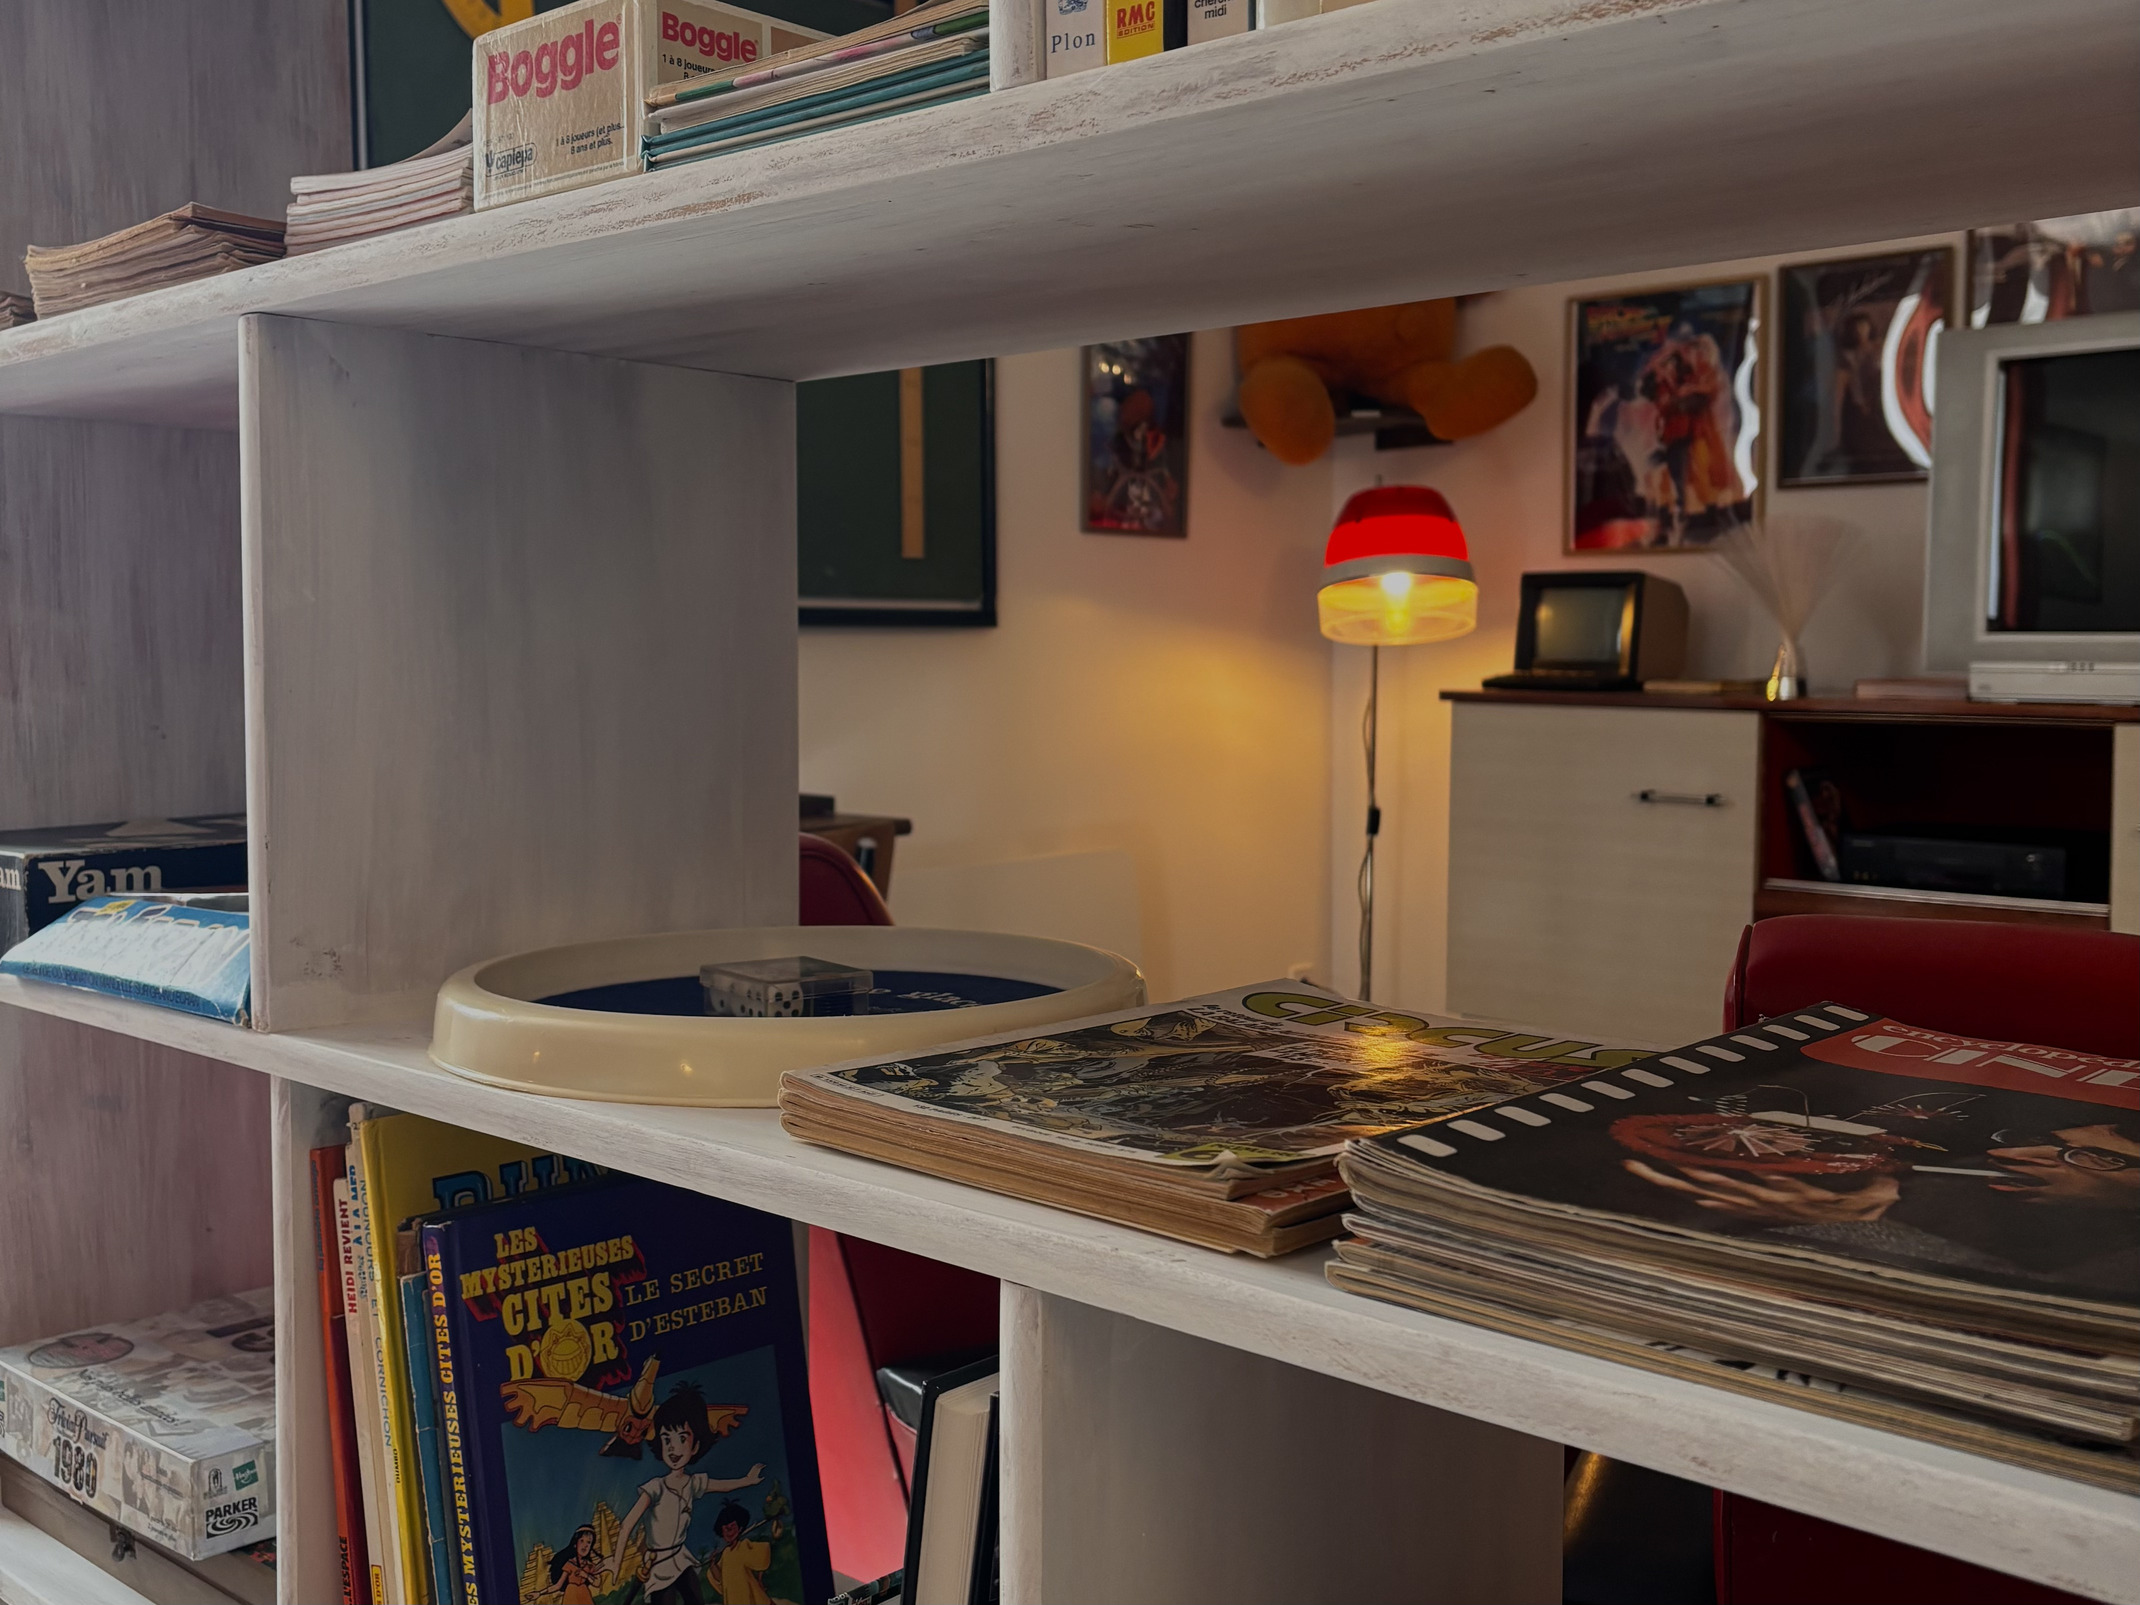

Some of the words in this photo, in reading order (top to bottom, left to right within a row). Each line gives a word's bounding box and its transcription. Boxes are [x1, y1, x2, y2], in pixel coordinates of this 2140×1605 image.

[1116, 1, 1156, 30] RMC
[1116, 22, 1155, 37] EDITION
[1204, 3, 1227, 19] midi
[662, 11, 757, 63] Boggle
[1051, 32, 1096, 54] Plon
[487, 18, 621, 105] Boggle
[662, 53, 667, 63] 1
[669, 55, 675, 66] à
[676, 57, 683, 68] 8
[571, 129, 595, 145] joueurs
[576, 143, 588, 154] ans
[589, 140, 596, 151] et
[0, 865, 21, 891] am
[38, 859, 163, 904] Yam
[338, 1199, 353, 1265] REVIENT
[494, 1226, 538, 1259] LES
[428, 1253, 446, 1308] D'OR
[459, 1235, 636, 1300] MYSTERIEUSES
[625, 1279, 660, 1307] LE
[669, 1252, 765, 1294] SECRET
[345, 1271, 357, 1313] HEIDI
[501, 1272, 615, 1337] CITES
[628, 1286, 769, 1342] D'ESTEBAN
[434, 1314, 454, 1384] CITES
[375, 1337, 392, 1447] CORNICHON
[53, 1436, 98, 1499] 1980
[443, 1391, 476, 1577] MYSTERIEUSES
[205, 1496, 258, 1523] PARKER
[465, 1581, 479, 1605] ES
